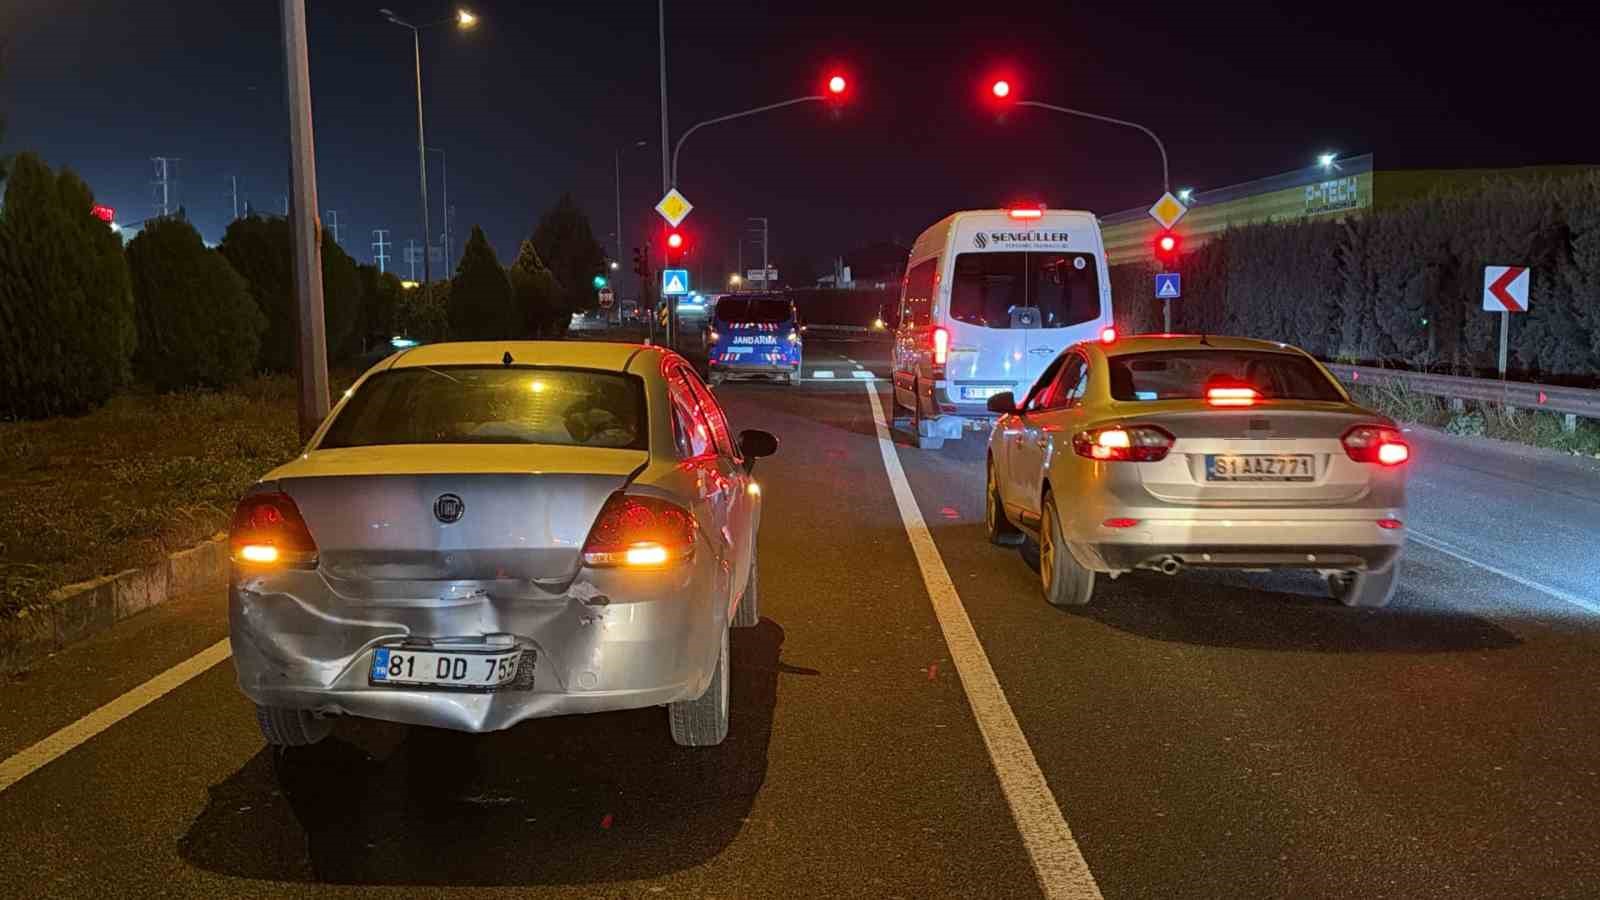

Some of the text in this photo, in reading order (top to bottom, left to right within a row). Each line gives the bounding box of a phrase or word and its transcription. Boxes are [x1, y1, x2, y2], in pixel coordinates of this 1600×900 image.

[991, 229, 1069, 244] ŞENGÜLLER
[732, 335, 777, 345] JANDARMA
[388, 655, 415, 678] 81
[436, 656, 468, 681] DD
